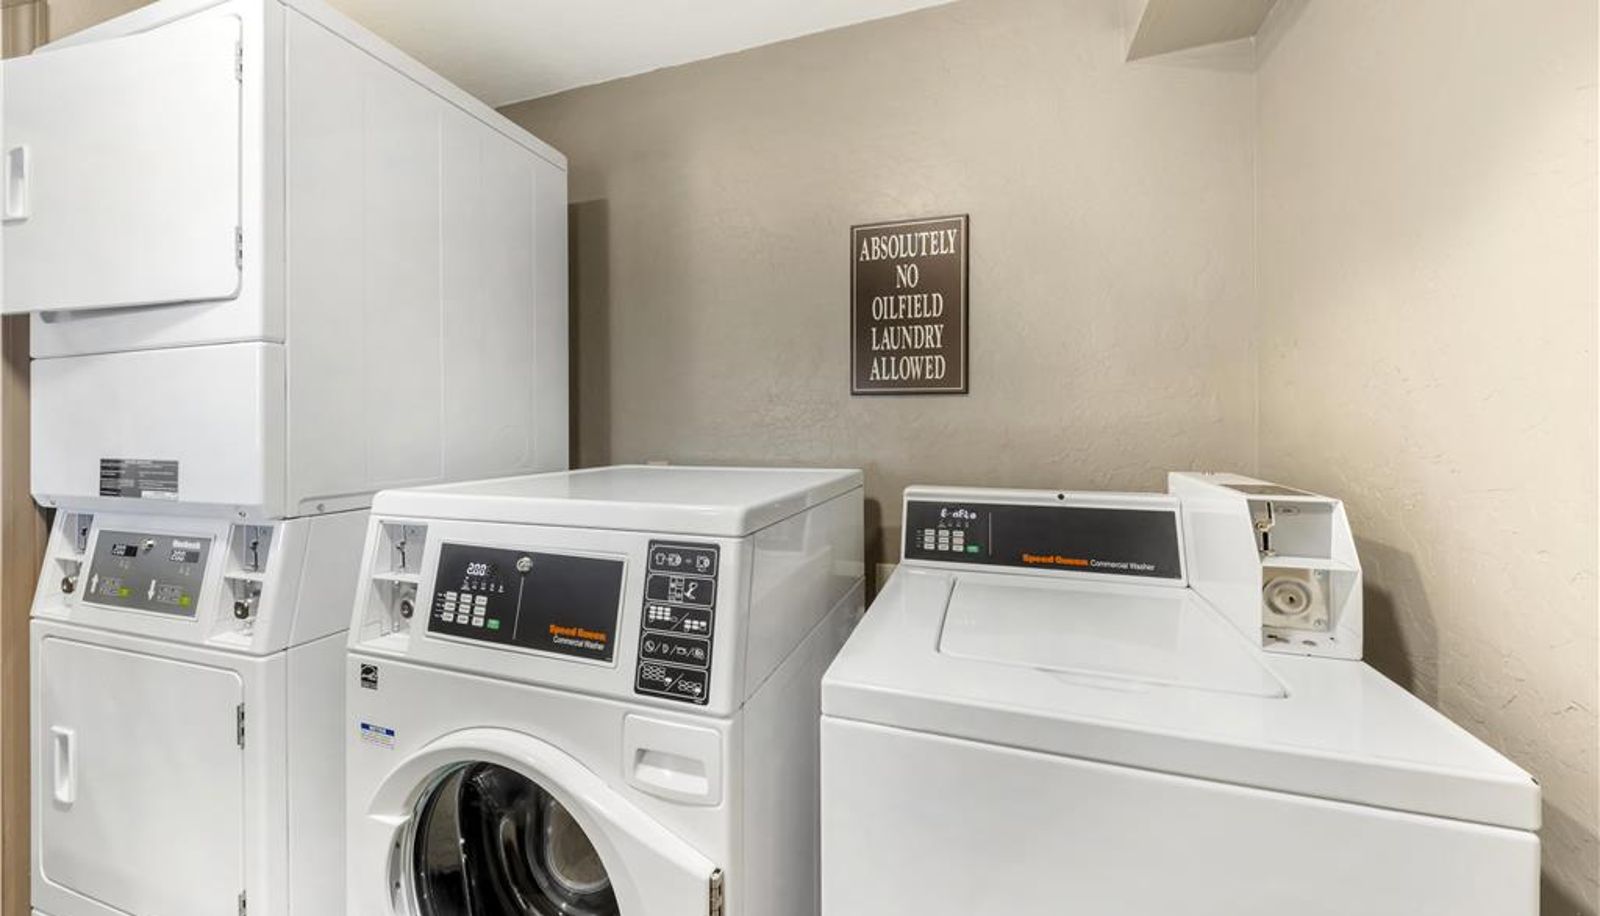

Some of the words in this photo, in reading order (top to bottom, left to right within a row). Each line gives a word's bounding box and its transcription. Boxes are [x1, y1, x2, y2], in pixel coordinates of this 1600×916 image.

[859, 229, 957, 261] ABSOLUTELY
[896, 263, 919, 288] NO
[872, 293, 944, 321] OILFIELD
[871, 324, 944, 350] LAUNDRY
[869, 355, 946, 380] ALLOWED
[466, 562, 486, 576] 200
[1023, 554, 1054, 565] Speed
[1055, 555, 1088, 566] Queen
[1090, 559, 1129, 570] Commercial
[1130, 562, 1155, 571] Washer
[549, 624, 577, 637] Speed
[577, 628, 606, 641] Queen
[553, 635, 583, 648] Commercial
[583, 641, 605, 651] Washer
